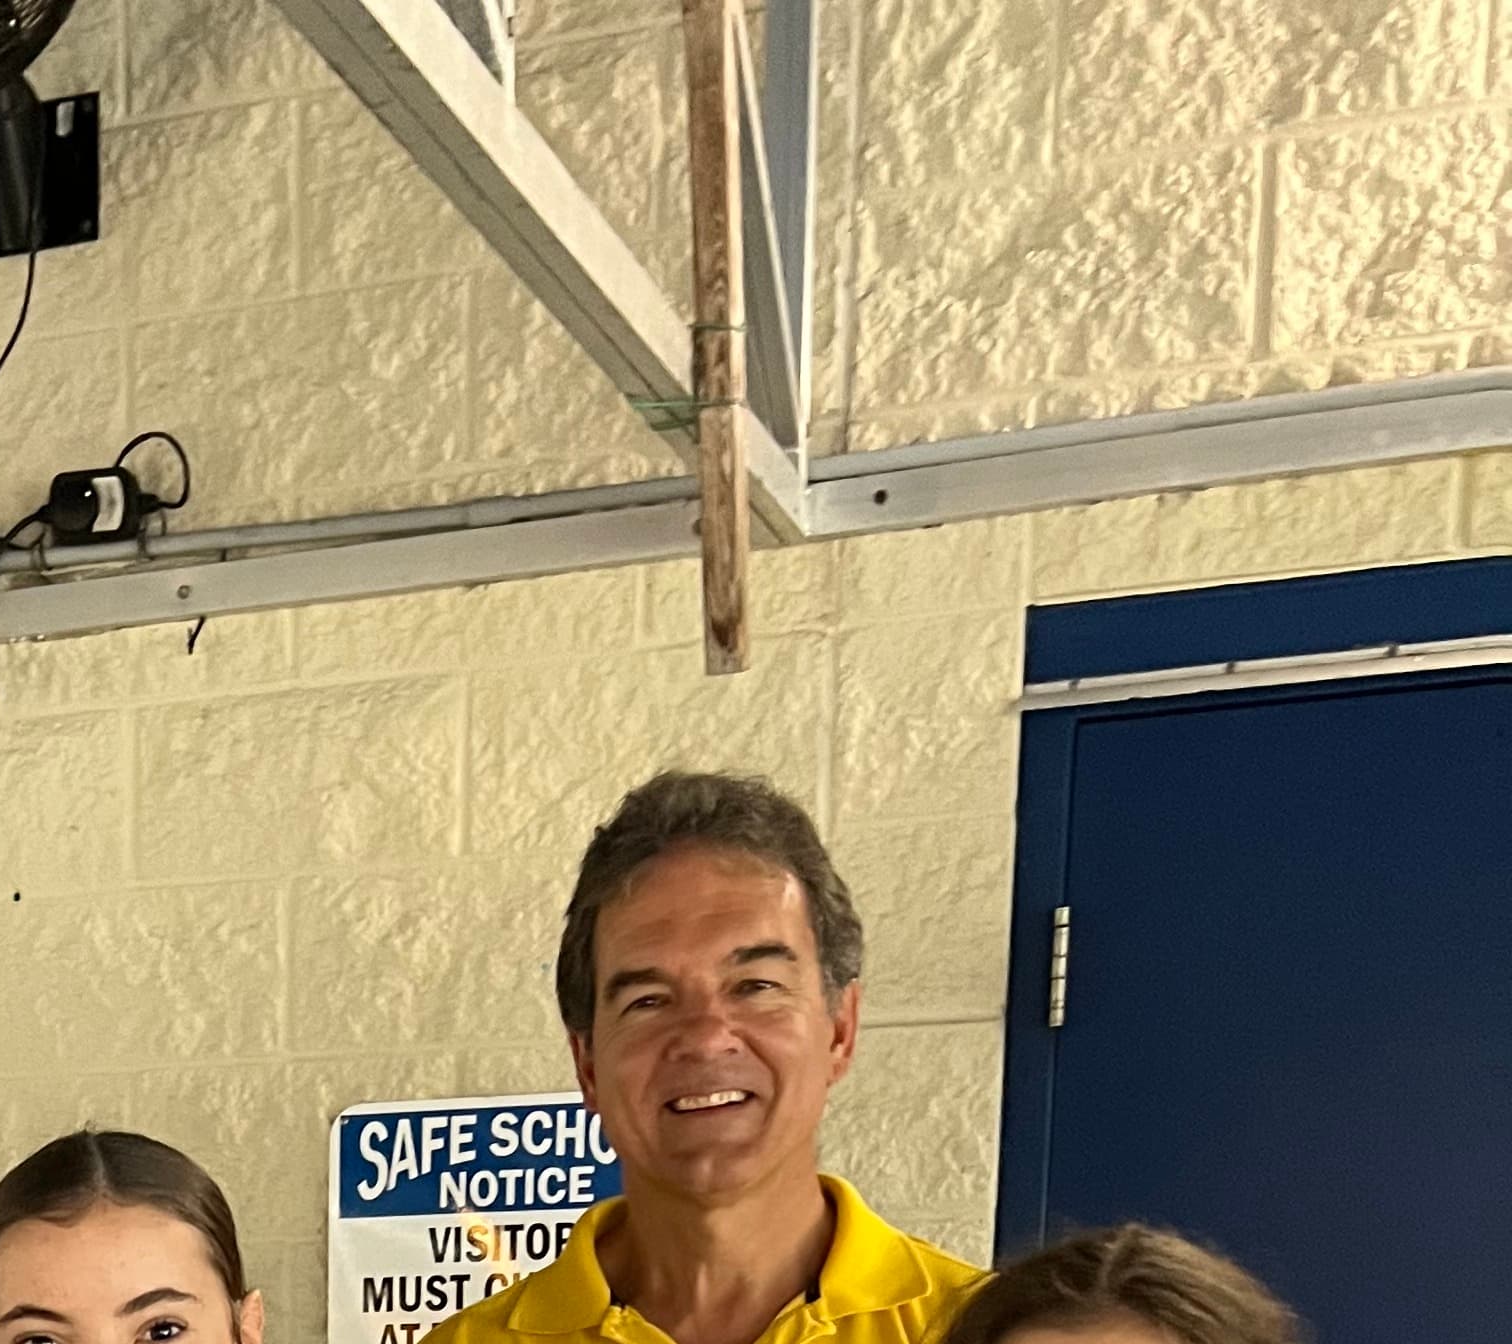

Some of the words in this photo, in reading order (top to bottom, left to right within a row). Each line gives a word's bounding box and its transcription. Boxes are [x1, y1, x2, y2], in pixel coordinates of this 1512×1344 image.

[357, 1114, 478, 1201] SAFE
[439, 1165, 595, 1208] NOTICE
[362, 1273, 471, 1313] MUST
